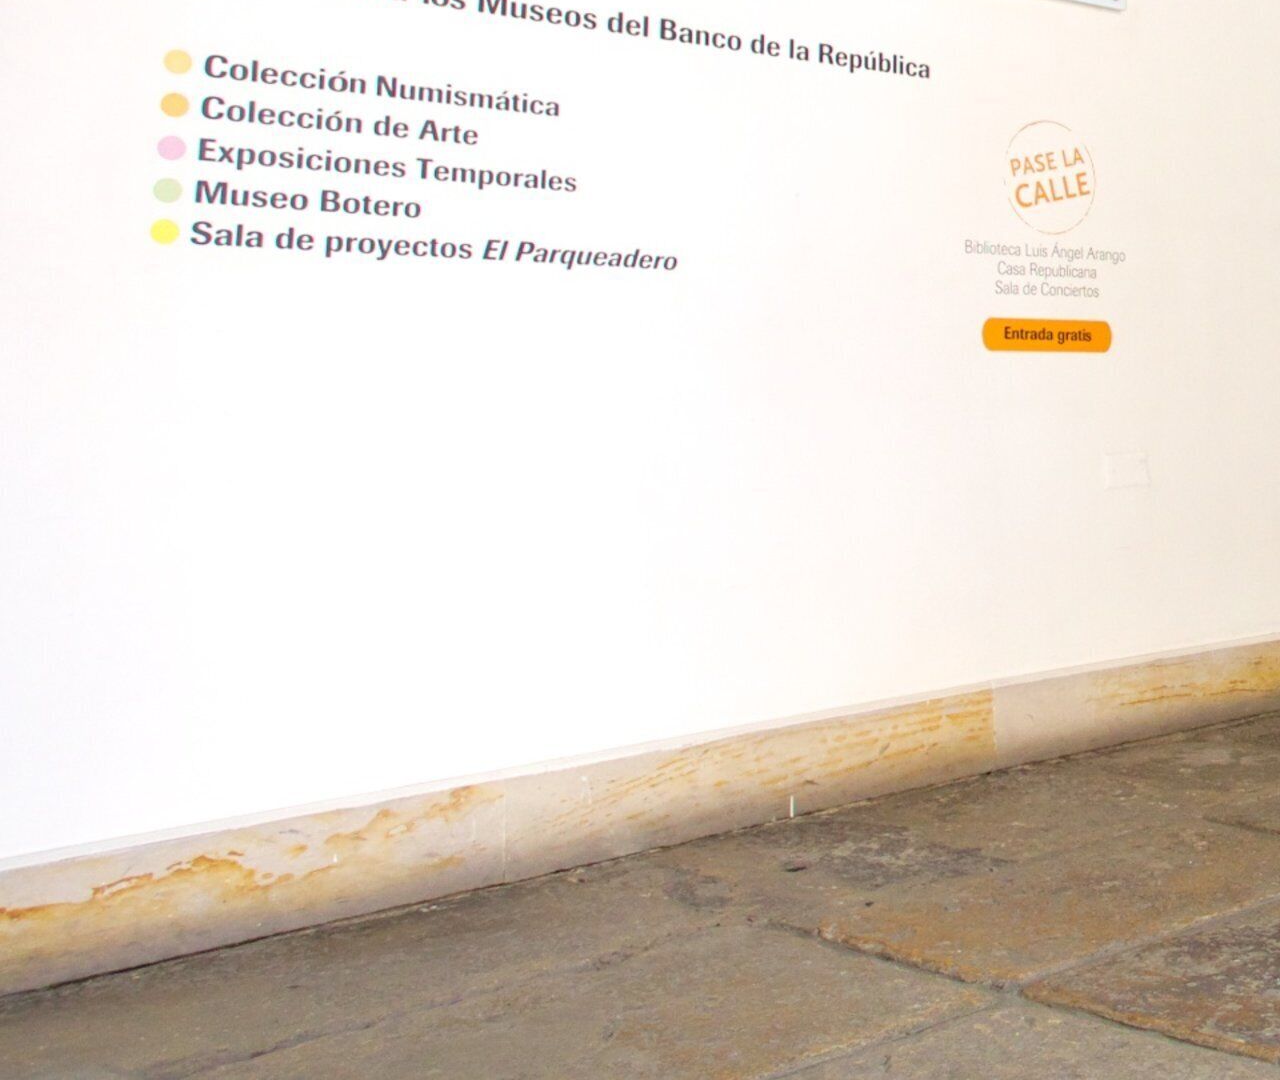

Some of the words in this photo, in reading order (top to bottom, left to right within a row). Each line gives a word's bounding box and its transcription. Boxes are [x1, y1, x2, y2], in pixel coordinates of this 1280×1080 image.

[607, 11, 649, 38] del
[659, 18, 742, 52] Banco
[750, 34, 780, 57] de
[789, 38, 810, 62] la
[818, 43, 931, 79] República
[204, 54, 367, 95] Colección
[376, 75, 561, 117] Numismática
[201, 95, 363, 134] Colección
[373, 115, 409, 139] de
[418, 119, 479, 146] Arte
[197, 137, 407, 179] Exposiciones
[416, 157, 578, 192] Temporales
[1009, 151, 1057, 177] PASE
[1062, 147, 1085, 168] LA
[194, 180, 309, 211] Museo
[320, 189, 422, 219] Botero
[1014, 172, 1091, 208] CALLE
[190, 220, 264, 248] Sala
[274, 227, 315, 251] de
[325, 233, 473, 261] proyectos
[482, 239, 509, 261] El
[515, 240, 678, 271] Parqueadero
[964, 238, 1021, 257] Biblioteca
[1025, 243, 1048, 258] Luis
[1050, 241, 1084, 263] Ángel
[1086, 246, 1127, 265] Arango
[997, 260, 1026, 276] Casa
[1029, 261, 1097, 280] Republicana
[995, 279, 1020, 296] Sala
[1023, 282, 1038, 296] de
[1040, 281, 1100, 299] Conciertos
[1003, 325, 1054, 342] Entrada
[1057, 328, 1093, 345] gratis
